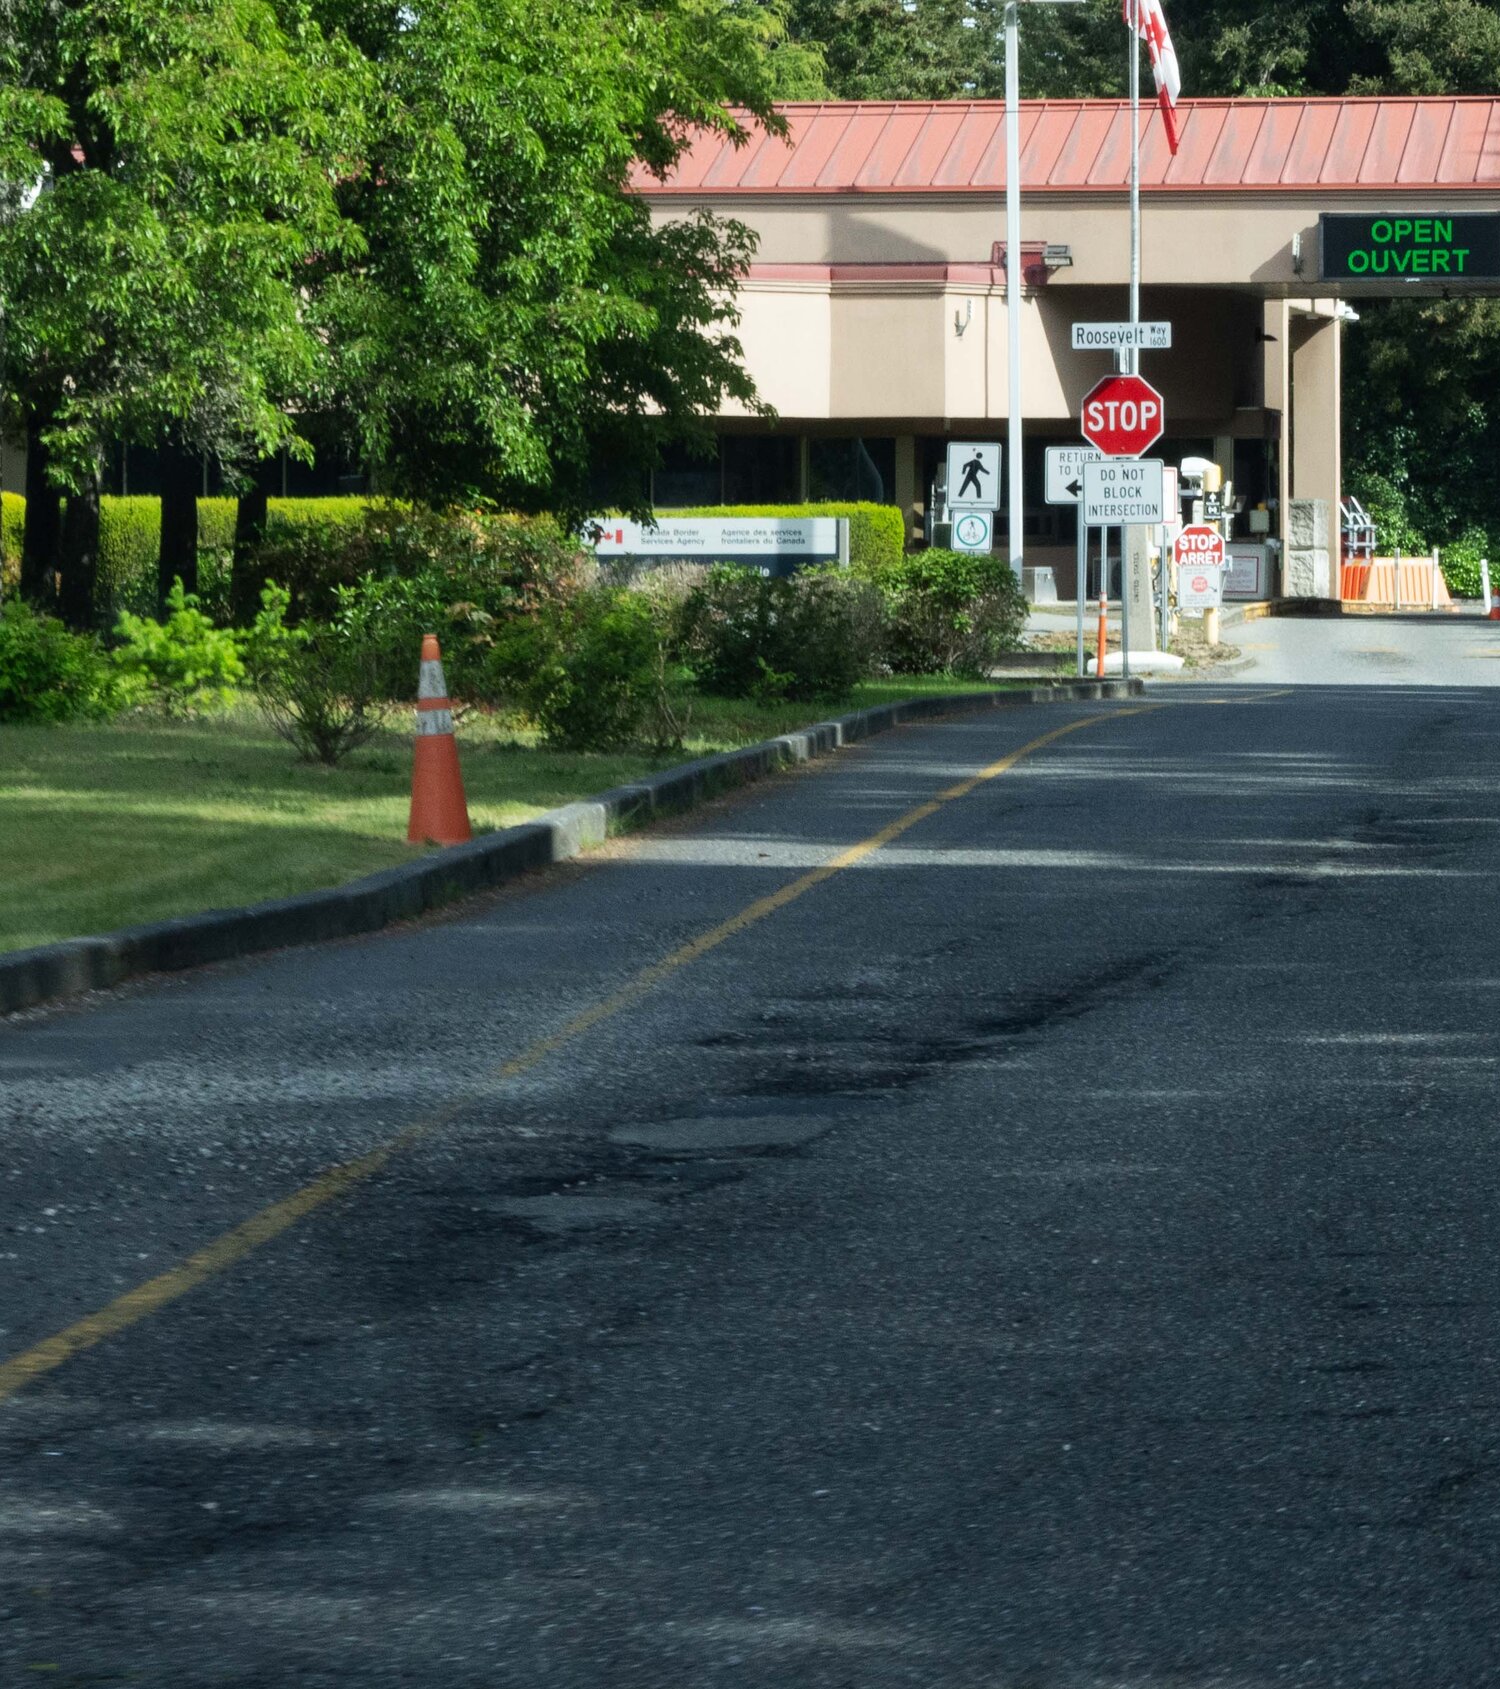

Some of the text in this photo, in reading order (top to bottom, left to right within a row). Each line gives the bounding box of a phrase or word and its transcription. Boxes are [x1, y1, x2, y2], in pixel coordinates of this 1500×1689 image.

[1371, 219, 1452, 243] OPEN
[1347, 249, 1470, 273] OUVERT
[1076, 326, 1166, 344] Roosevelt Way
[1150, 337, 1166, 346] 1600
[1088, 401, 1157, 432] STOP
[1059, 452, 1101, 461] RETURN
[1059, 466, 1071, 475] TO
[1100, 469, 1145, 481] DO NOT
[1104, 487, 1142, 499] BLOCK
[1088, 504, 1158, 517] INTERSECTION
[673, 528, 699, 536] Border
[721, 529, 750, 537] Agence
[677, 538, 705, 546] Agency
[721, 537, 760, 545] frontaliers
[1179, 534, 1218, 550] STOP
[1179, 549, 1220, 565] ARRÊT
